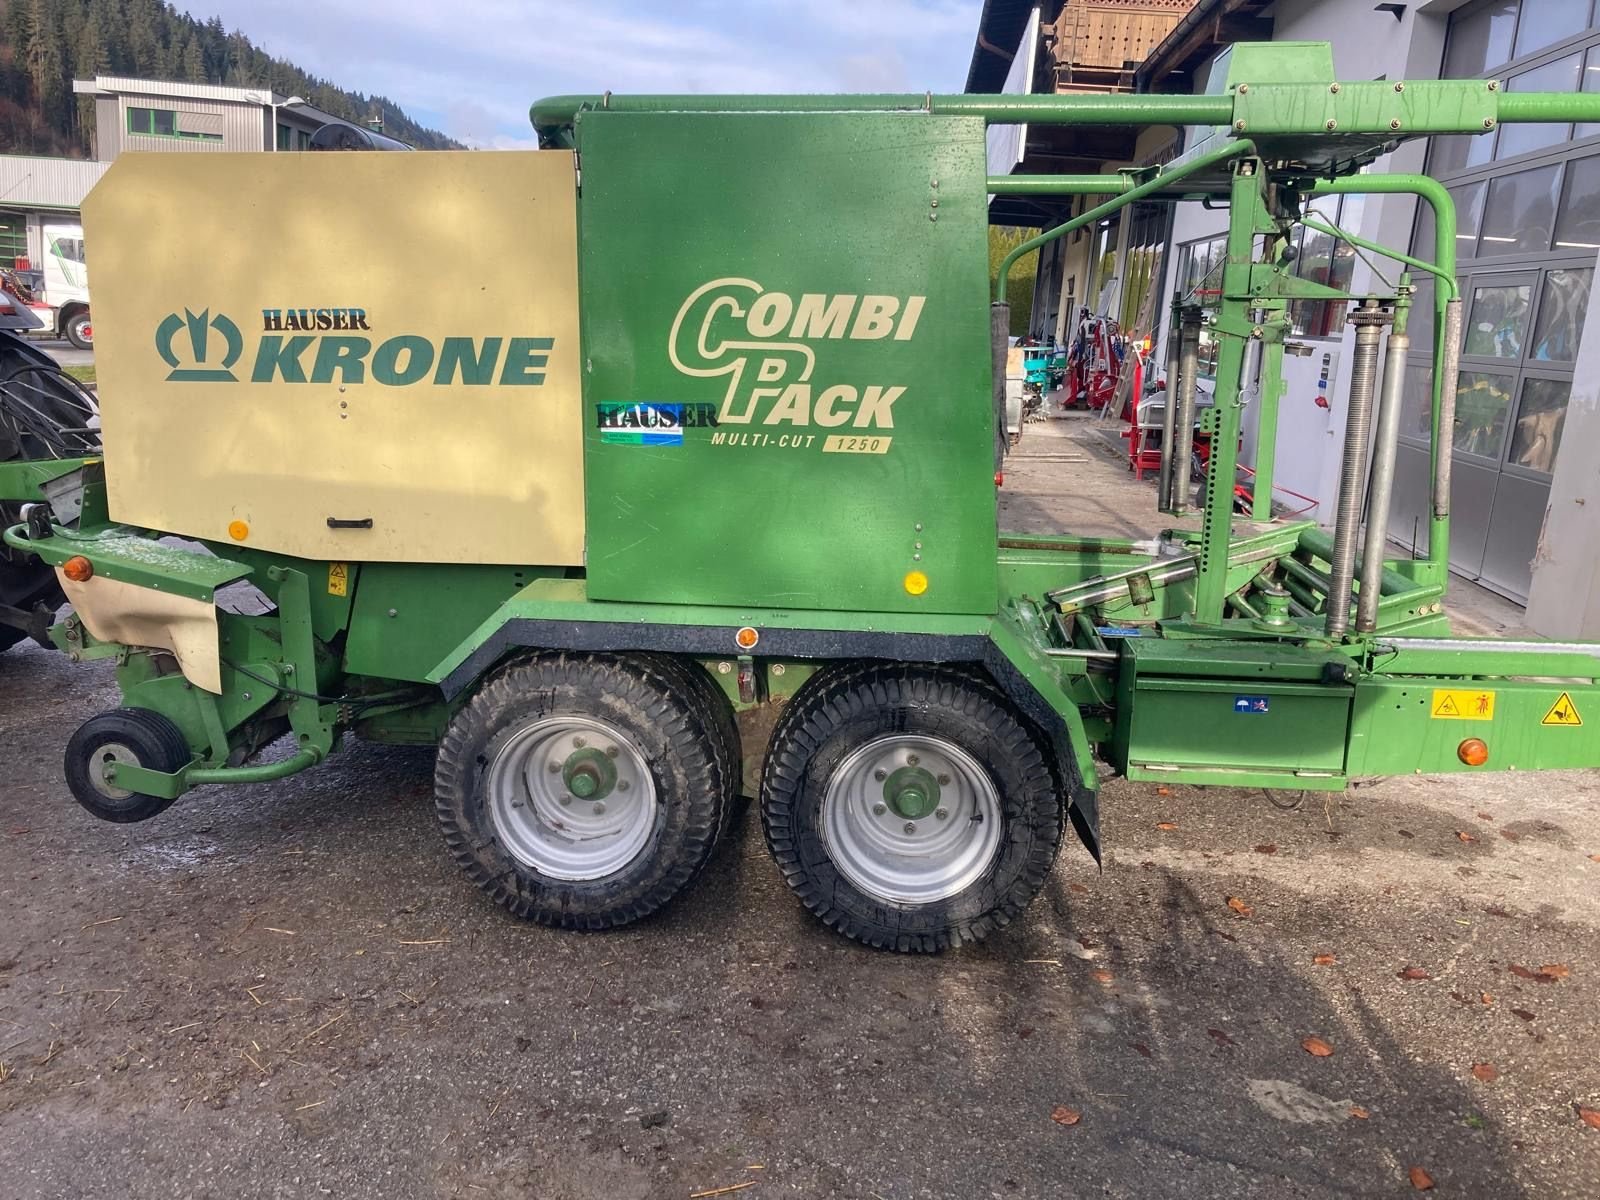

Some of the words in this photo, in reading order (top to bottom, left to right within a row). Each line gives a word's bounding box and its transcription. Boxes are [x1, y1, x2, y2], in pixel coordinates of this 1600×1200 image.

[262, 308, 370, 331] HAUSER
[668, 277, 926, 377] COMBI
[251, 335, 555, 386] KRONE
[717, 345, 907, 428] PACK
[596, 403, 720, 428] HAUSER
[711, 432, 816, 448] MULTI-CUT
[836, 438, 880, 451] 1250
